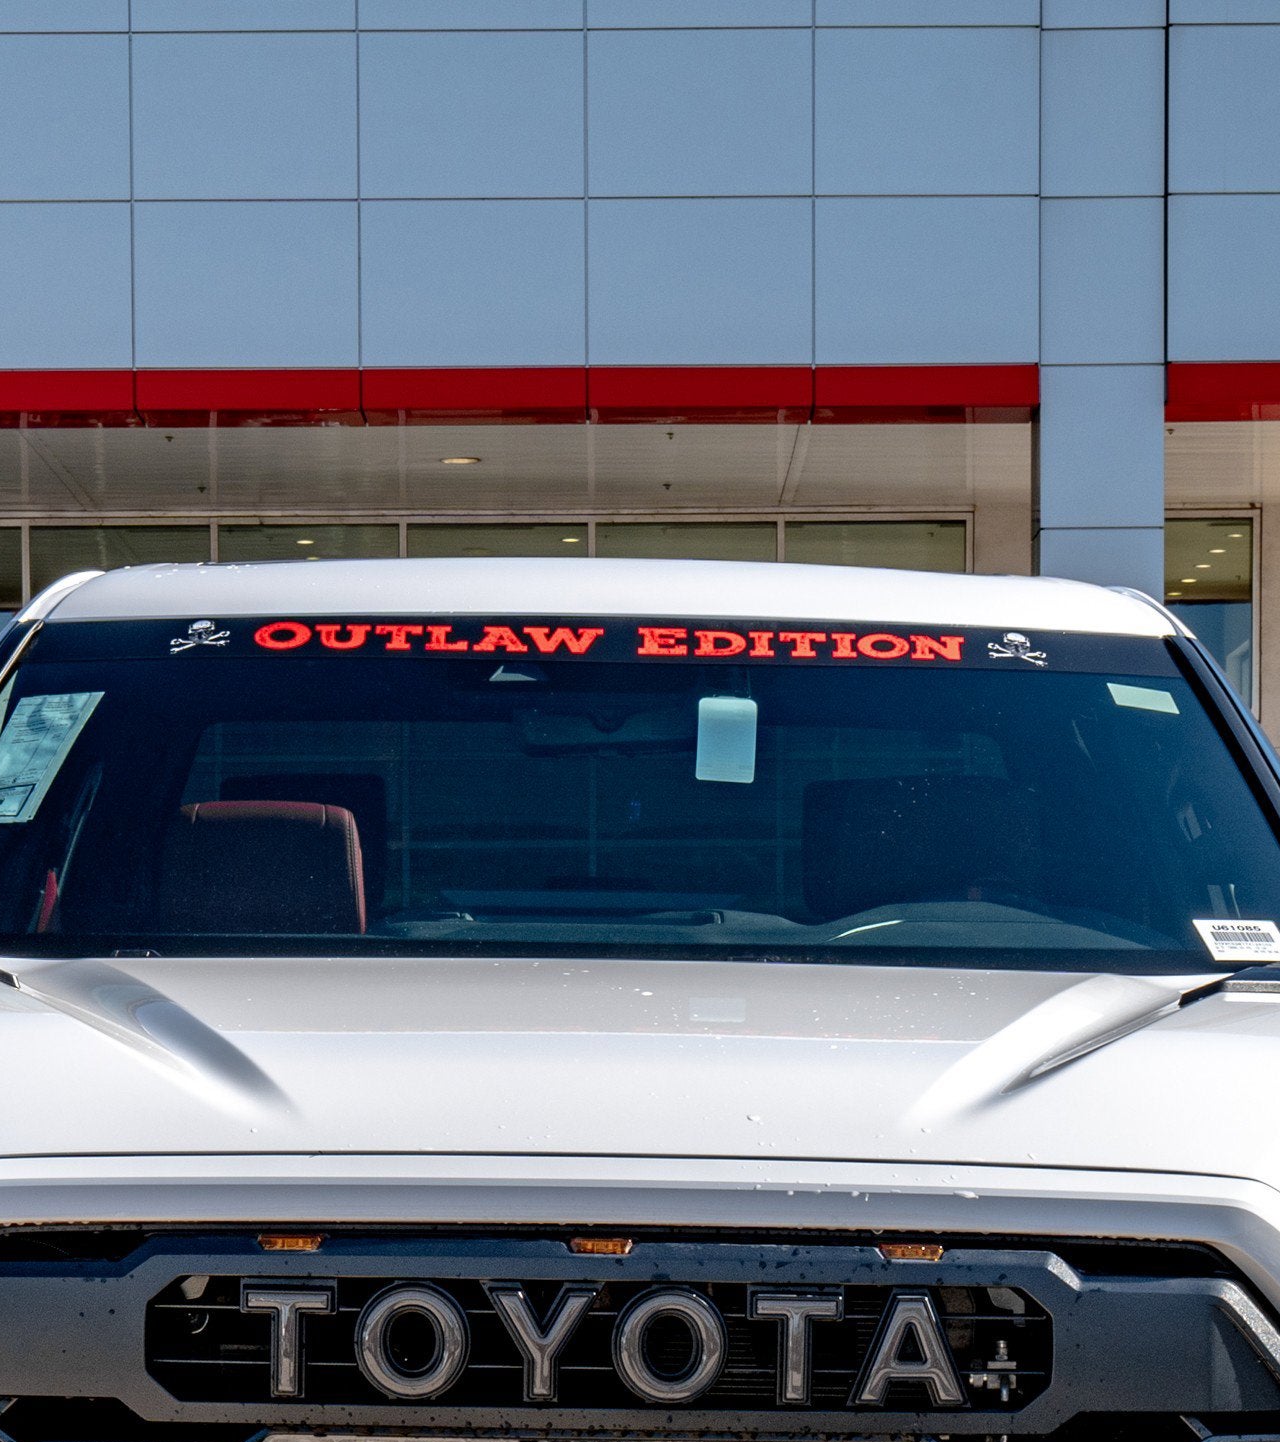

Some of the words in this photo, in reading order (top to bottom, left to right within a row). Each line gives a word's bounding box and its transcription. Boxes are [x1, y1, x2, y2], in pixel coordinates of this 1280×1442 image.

[254, 621, 604, 655] OUTLAW
[637, 627, 965, 661] EDITION
[241, 1279, 970, 1407] TOYOTA
